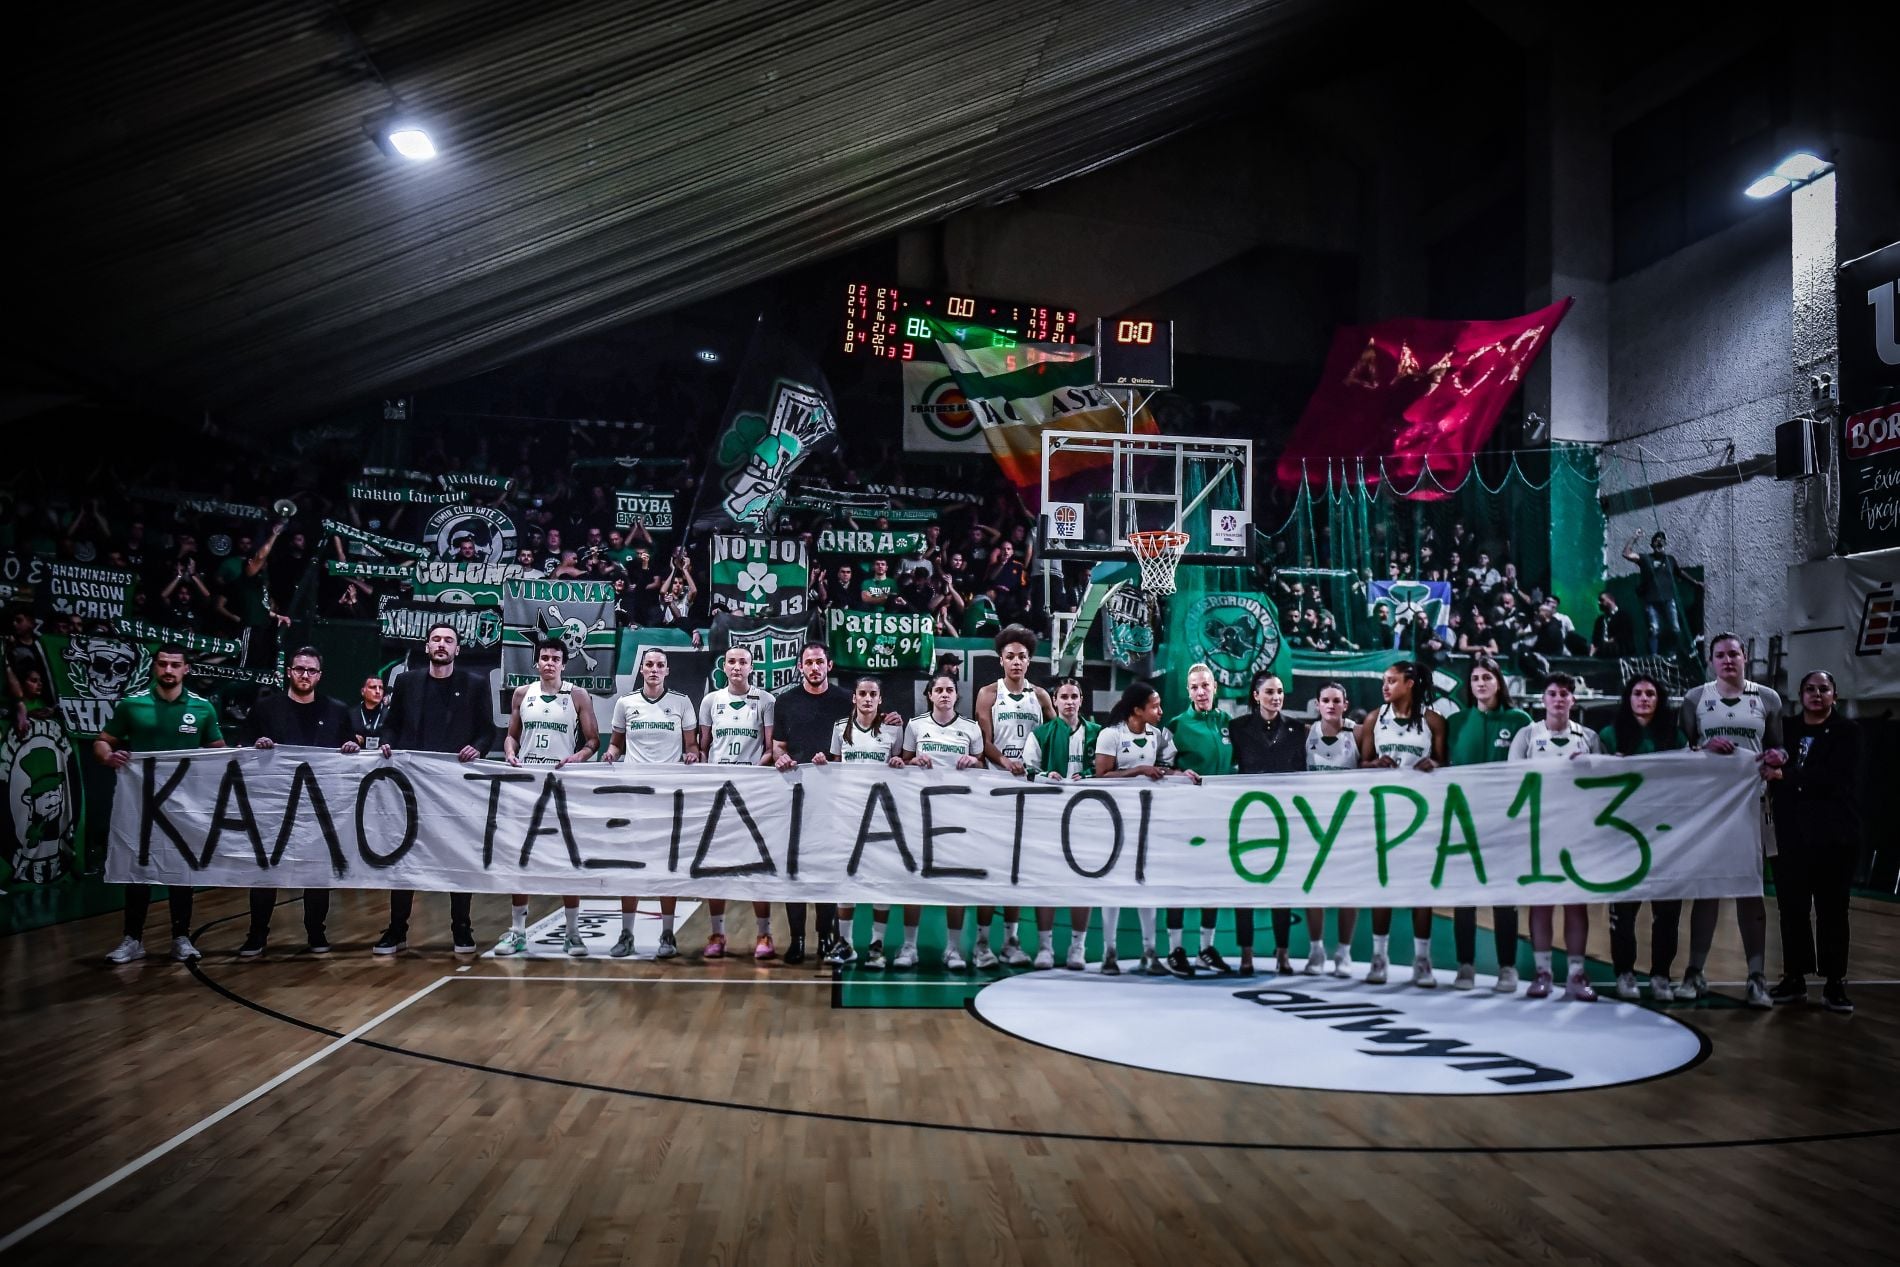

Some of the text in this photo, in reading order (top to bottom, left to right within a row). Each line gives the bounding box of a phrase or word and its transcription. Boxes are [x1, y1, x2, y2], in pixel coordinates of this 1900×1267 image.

[848, 284, 898, 300] 0 2 12 4
[847, 296, 855, 306] 2
[859, 298, 867, 307] 4
[876, 300, 886, 310] 15
[847, 308, 855, 318] 4
[876, 311, 885, 321] 16
[1030, 307, 1075, 323] 7 5 16 3
[847, 320, 897, 335] 6 21 2
[906, 317, 932, 339] 86
[1029, 318, 1065, 333] 9 4 18
[846, 331, 885, 345] 8 4 22
[1027, 330, 1037, 339] 11
[1051, 333, 1065, 343] 21
[844, 342, 897, 358] 10 77 3
[902, 343, 914, 359] 3
[475, 506, 497, 519] GATE
[617, 497, 672, 513] ΓΟΥΒΑ
[655, 514, 673, 526] 13
[817, 530, 895, 554] ΘΗΒΑ
[51, 578, 124, 601] GLASGOW
[75, 600, 123, 620] CREW
[780, 593, 803, 616] 13
[830, 607, 934, 635] Patissia
[846, 637, 922, 655] 19 94
[866, 653, 899, 668] club
[596, 677, 614, 690] UP
[630, 721, 675, 731] PANATHINAIKOS
[1017, 724, 1024, 737] 0
[535, 734, 549, 749] 15
[728, 741, 741, 755] 10
[921, 742, 966, 755] PANATHINAIKOS
[138, 757, 419, 879] ΚΑΛΟ
[463, 770, 805, 881] ΤΑΞΙΔΙ
[847, 781, 1153, 886] ΑΕΤΟΙ
